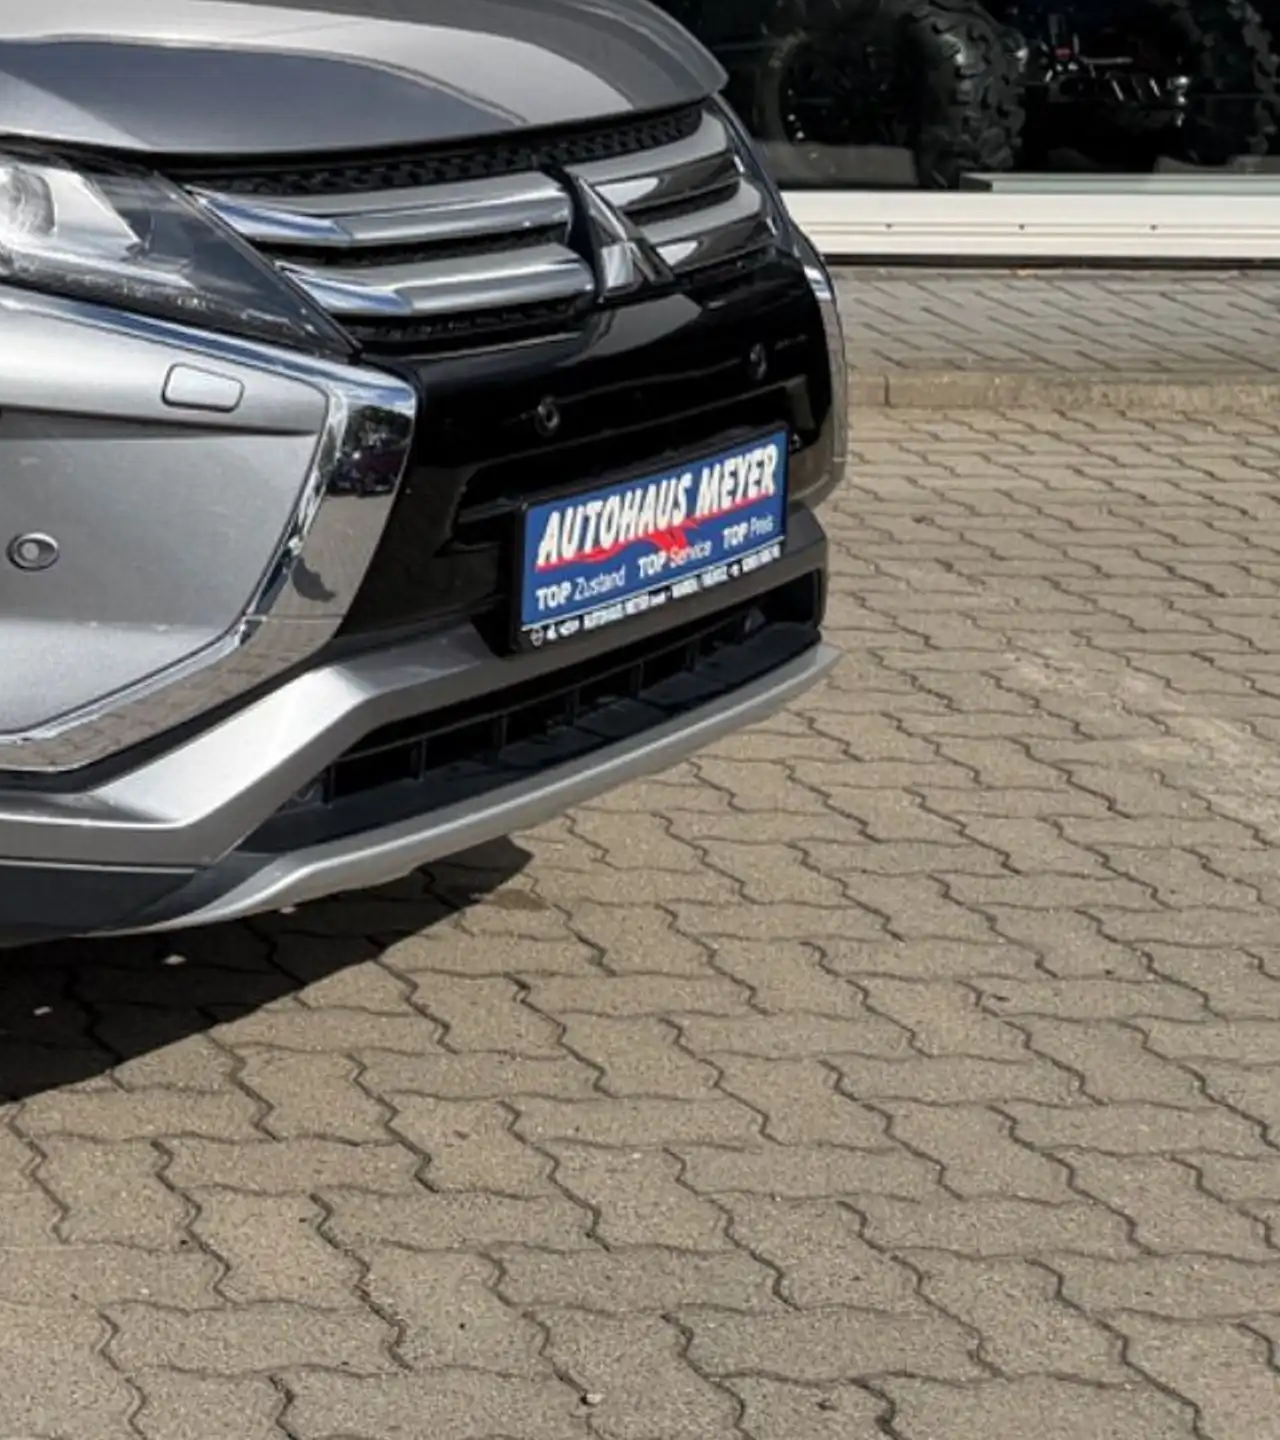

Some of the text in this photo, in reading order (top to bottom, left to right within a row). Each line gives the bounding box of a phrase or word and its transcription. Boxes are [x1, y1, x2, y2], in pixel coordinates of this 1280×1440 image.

[536, 443, 779, 567] AUTOHAUS MEYER
[535, 580, 572, 611] TOP
[573, 564, 626, 601] Zustand
[637, 549, 668, 579] TOP
[669, 540, 713, 569] Service
[723, 521, 749, 550] TOP
